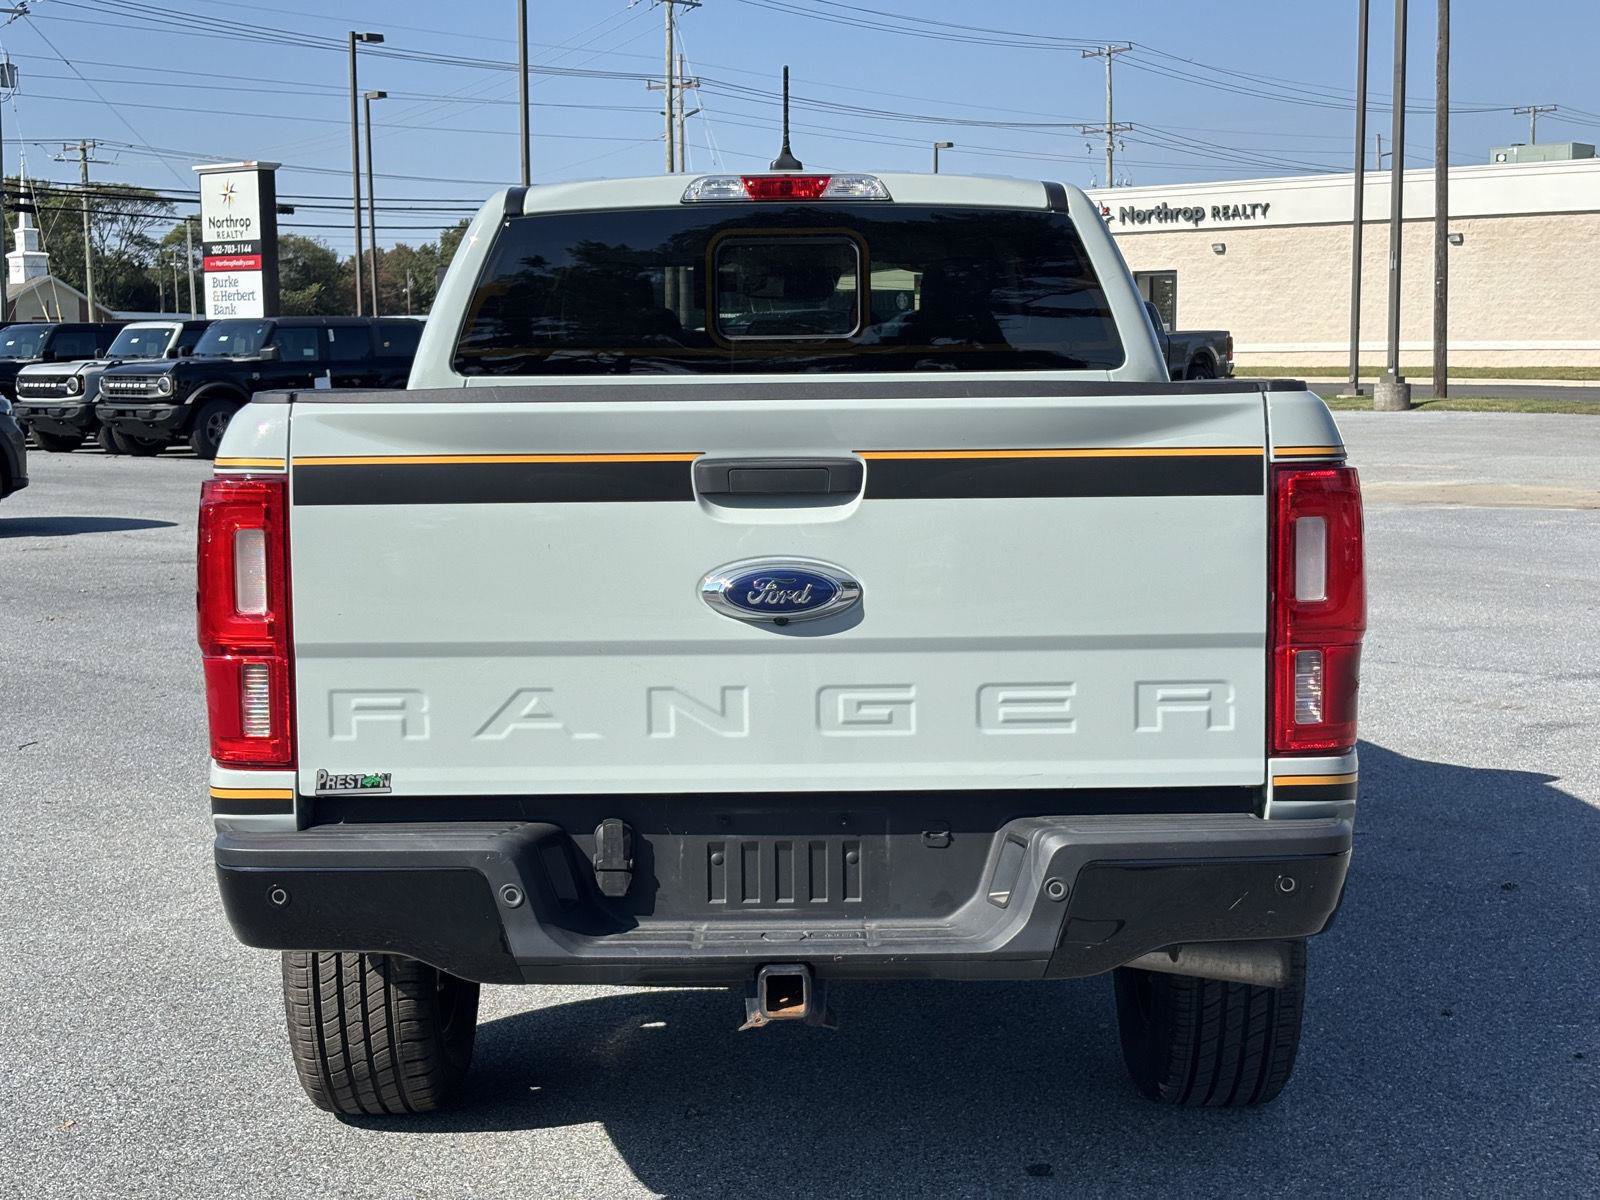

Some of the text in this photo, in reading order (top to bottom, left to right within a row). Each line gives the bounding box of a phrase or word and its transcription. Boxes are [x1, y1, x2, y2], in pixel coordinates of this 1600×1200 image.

[208, 214, 251, 231] Northrop
[1119, 202, 1270, 227] Northrop REALTY
[216, 230, 244, 240] REALTY
[211, 244, 252, 255] 302-703-1144
[212, 275, 239, 289] Burke
[213, 303, 237, 316] Bank
[747, 577, 813, 605] Ford
[328, 678, 1236, 741] RANGER
[316, 768, 392, 790] PRESTN
